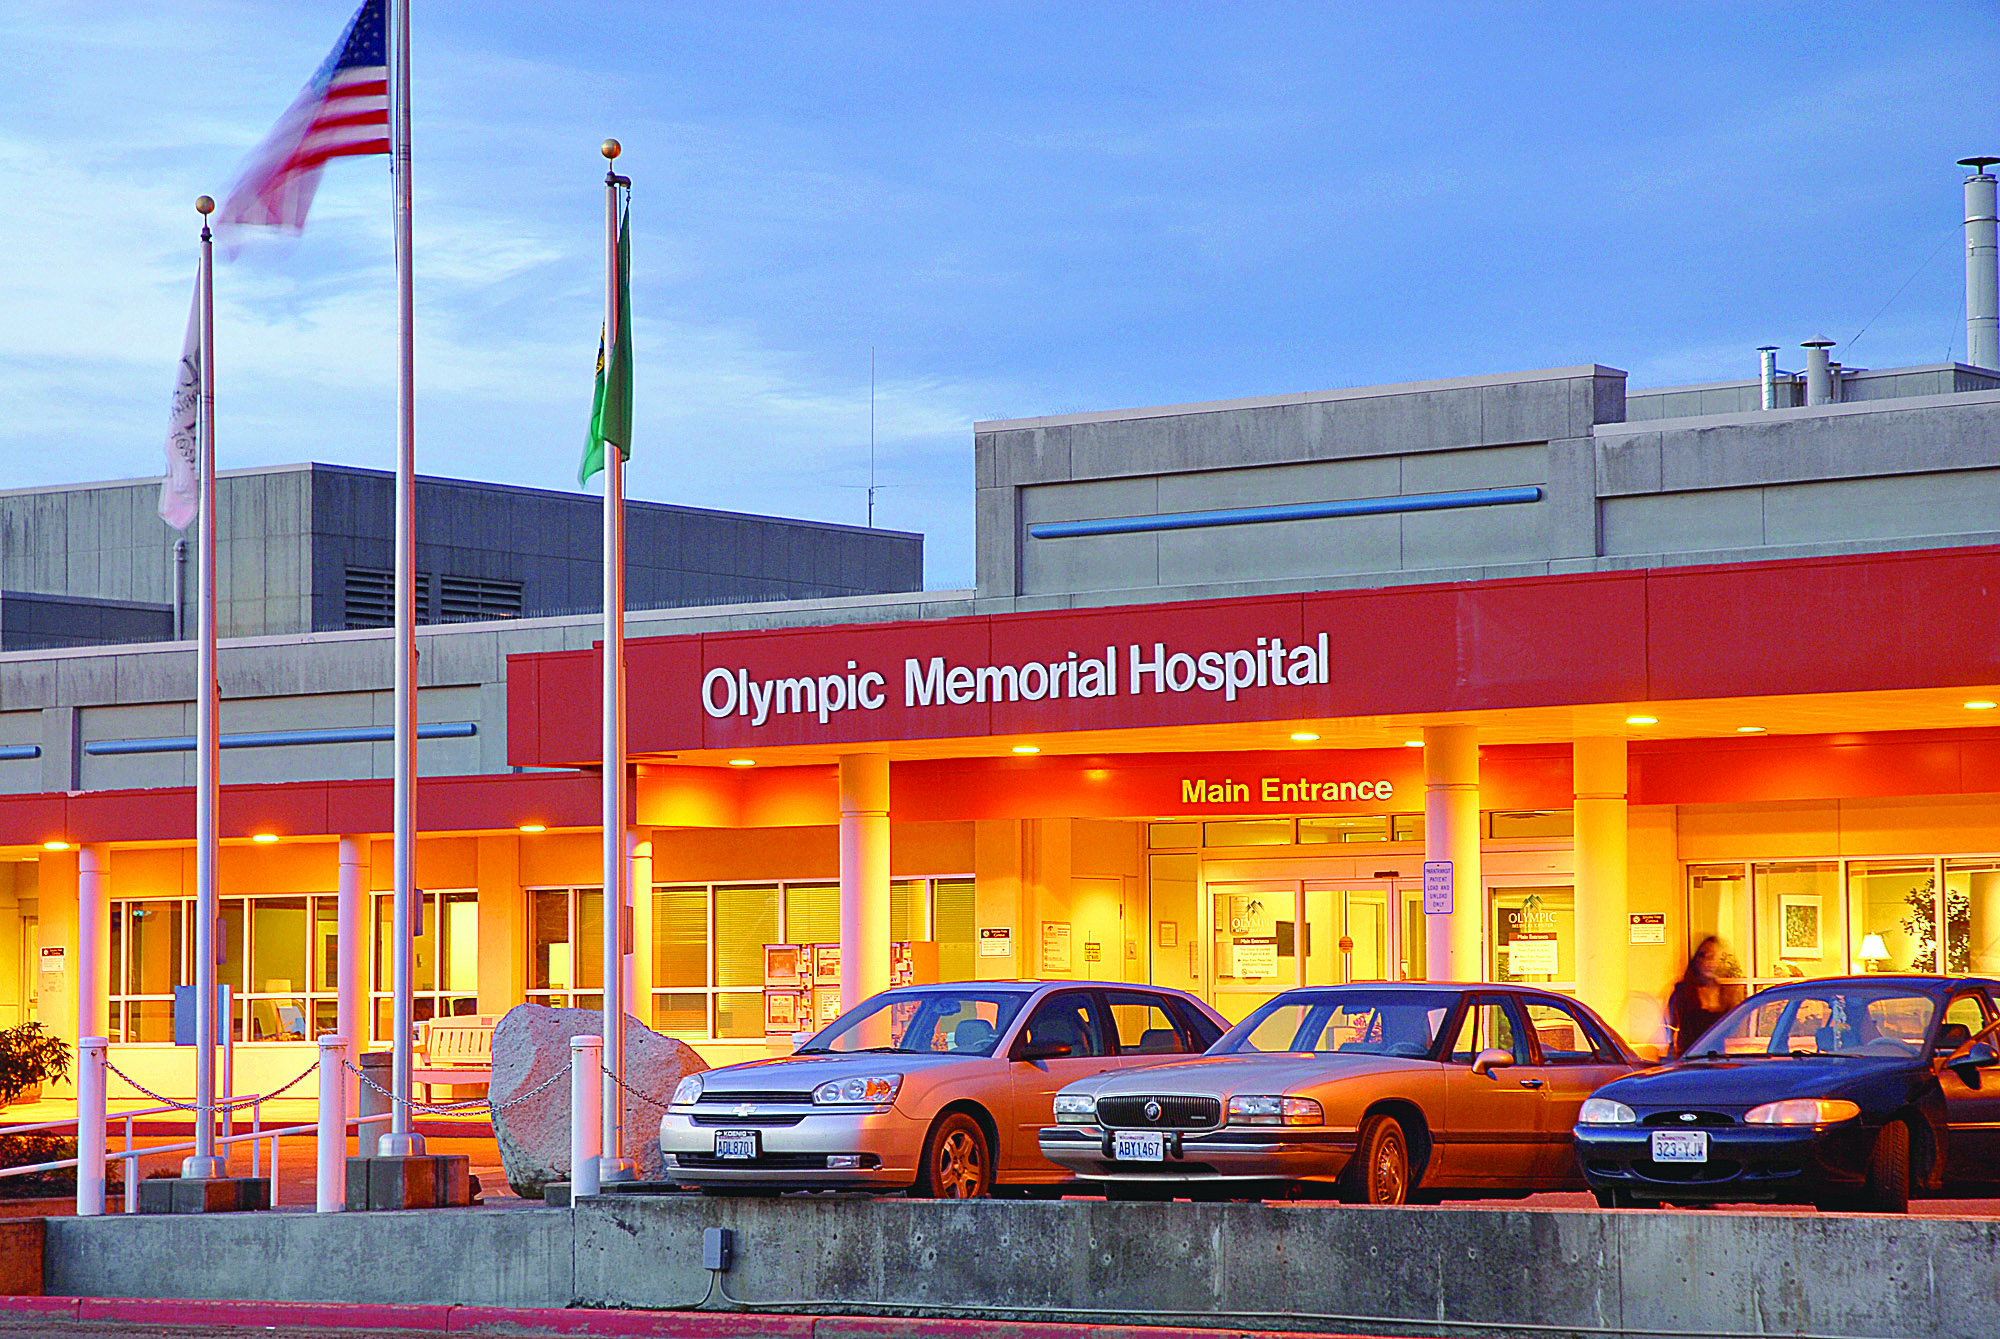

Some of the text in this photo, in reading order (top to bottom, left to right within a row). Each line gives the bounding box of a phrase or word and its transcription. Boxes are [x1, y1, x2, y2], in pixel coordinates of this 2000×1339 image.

[702, 632, 1329, 726] Olympic Memorial Hospital
[1181, 778, 1393, 803] Main Entrance
[1508, 912, 1557, 924] OLYMPIC
[1119, 1141, 1160, 1156] ABY1467
